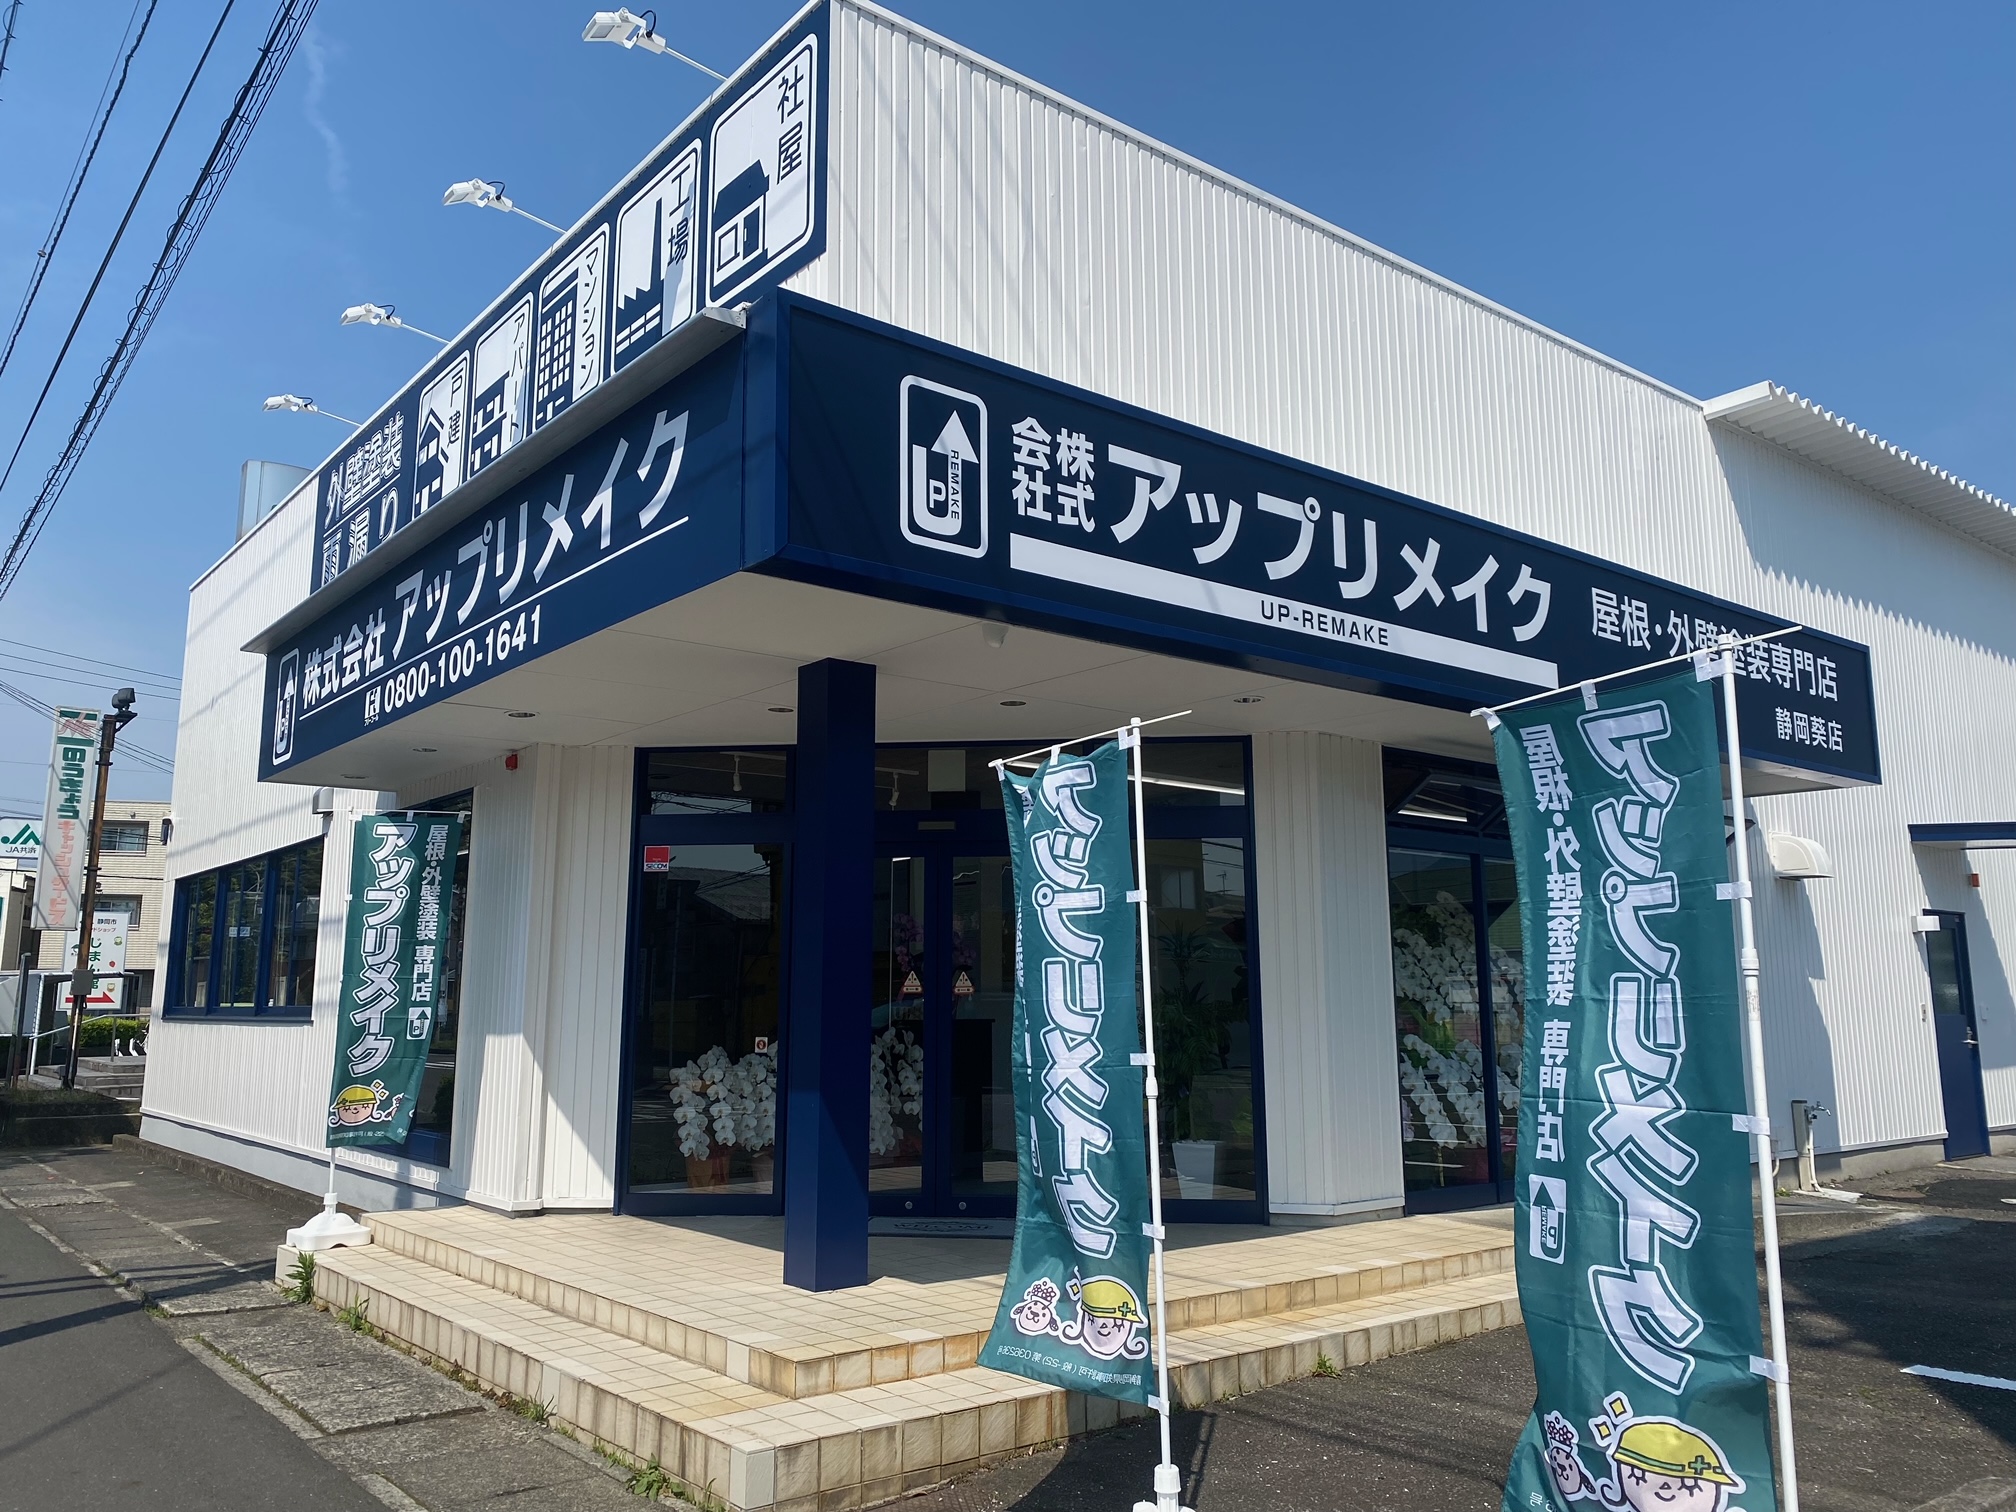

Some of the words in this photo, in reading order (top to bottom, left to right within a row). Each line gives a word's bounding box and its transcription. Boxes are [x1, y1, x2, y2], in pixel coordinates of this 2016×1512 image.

[776, 64, 804, 186] 社屋
[667, 164, 692, 266] 工場
[509, 313, 527, 430] アパート
[580, 248, 599, 391] マンション
[446, 372, 463, 444] 戸建
[325, 411, 404, 529] 外壁塗装
[950, 449, 960, 519] REMAKE
[303, 607, 385, 709] 株式会社
[392, 409, 689, 660] アップリメイク
[1107, 442, 1552, 643] アップリメイク
[385, 604, 542, 713] 0800-100-1641
[1260, 600, 1390, 646] UP-REMAKE
[1775, 707, 1843, 753] 静岡葵店
[348, 823, 418, 1078] アップリメイク
